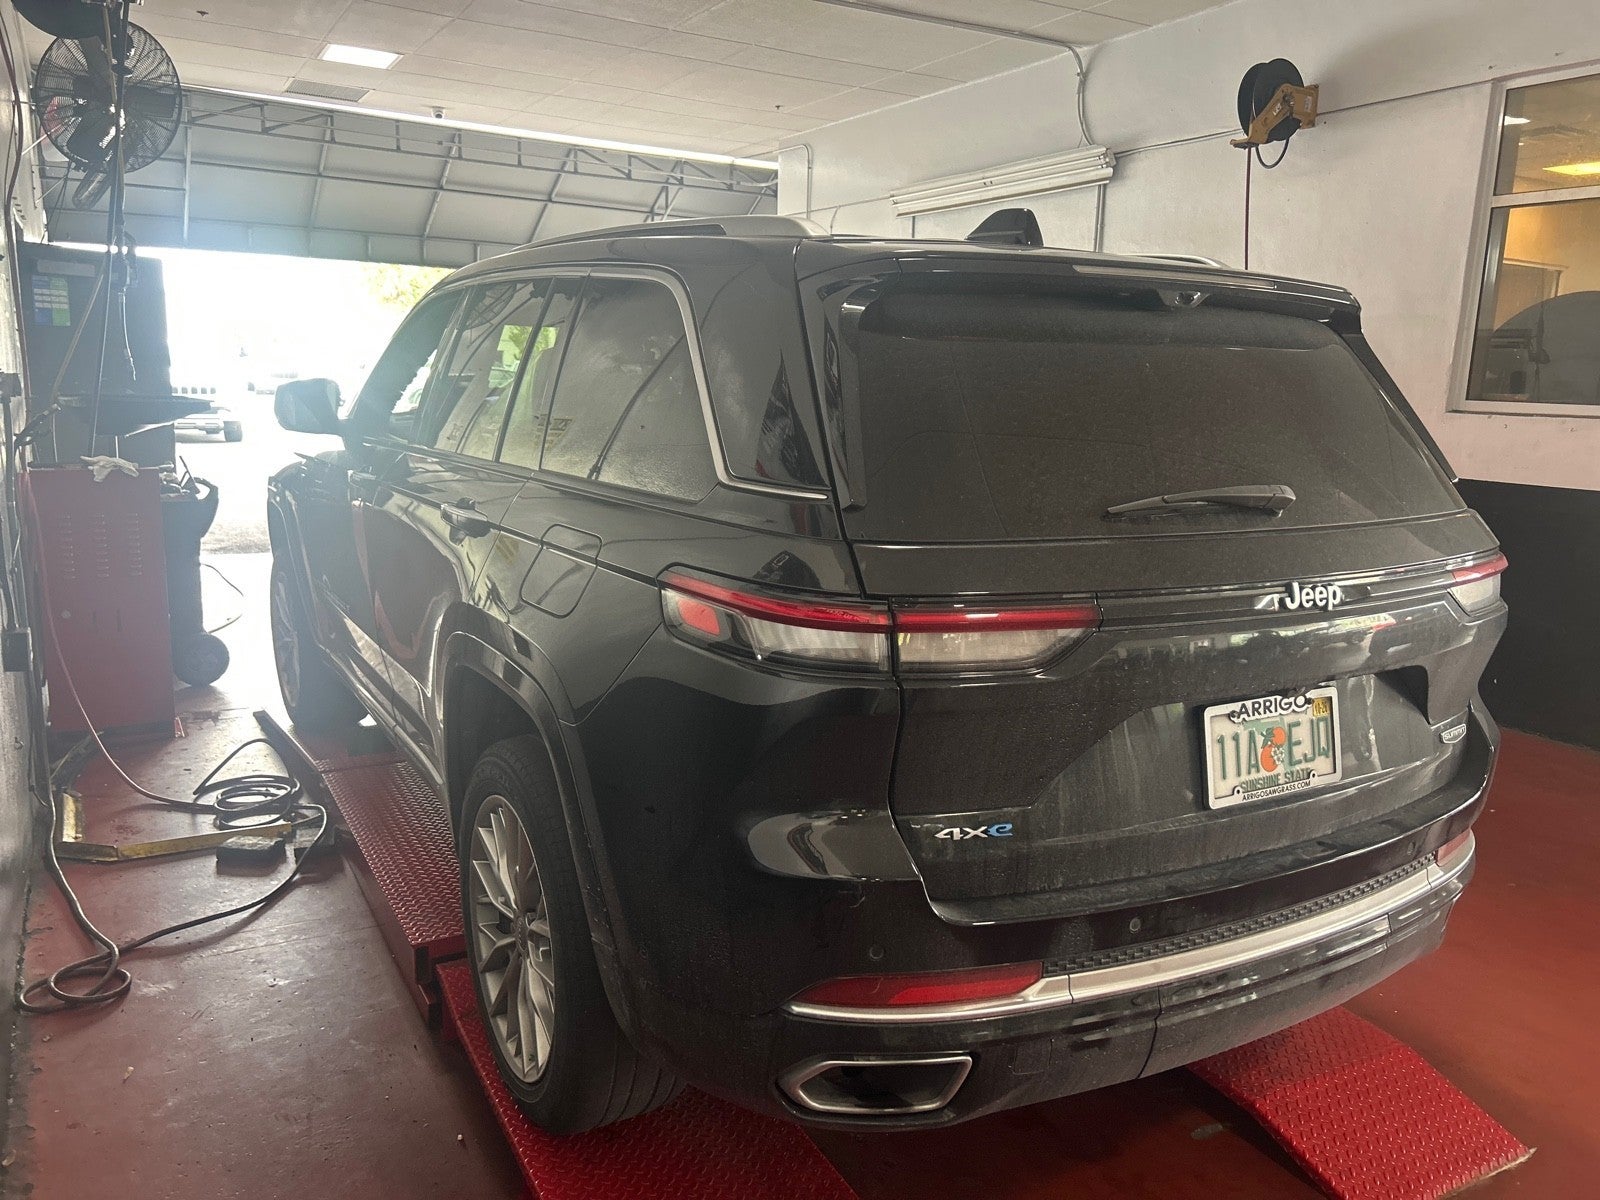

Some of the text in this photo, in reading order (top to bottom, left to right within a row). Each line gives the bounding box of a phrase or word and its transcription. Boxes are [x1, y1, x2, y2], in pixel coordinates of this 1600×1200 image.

[1285, 581, 1342, 611] Jeep
[1238, 695, 1307, 718] ARRIGO
[1217, 716, 1330, 780] 11A EJQ
[1240, 767, 1311, 793] SUNSHINE STATE
[1242, 780, 1311, 802] ARRIGOSAWGRASS.COM
